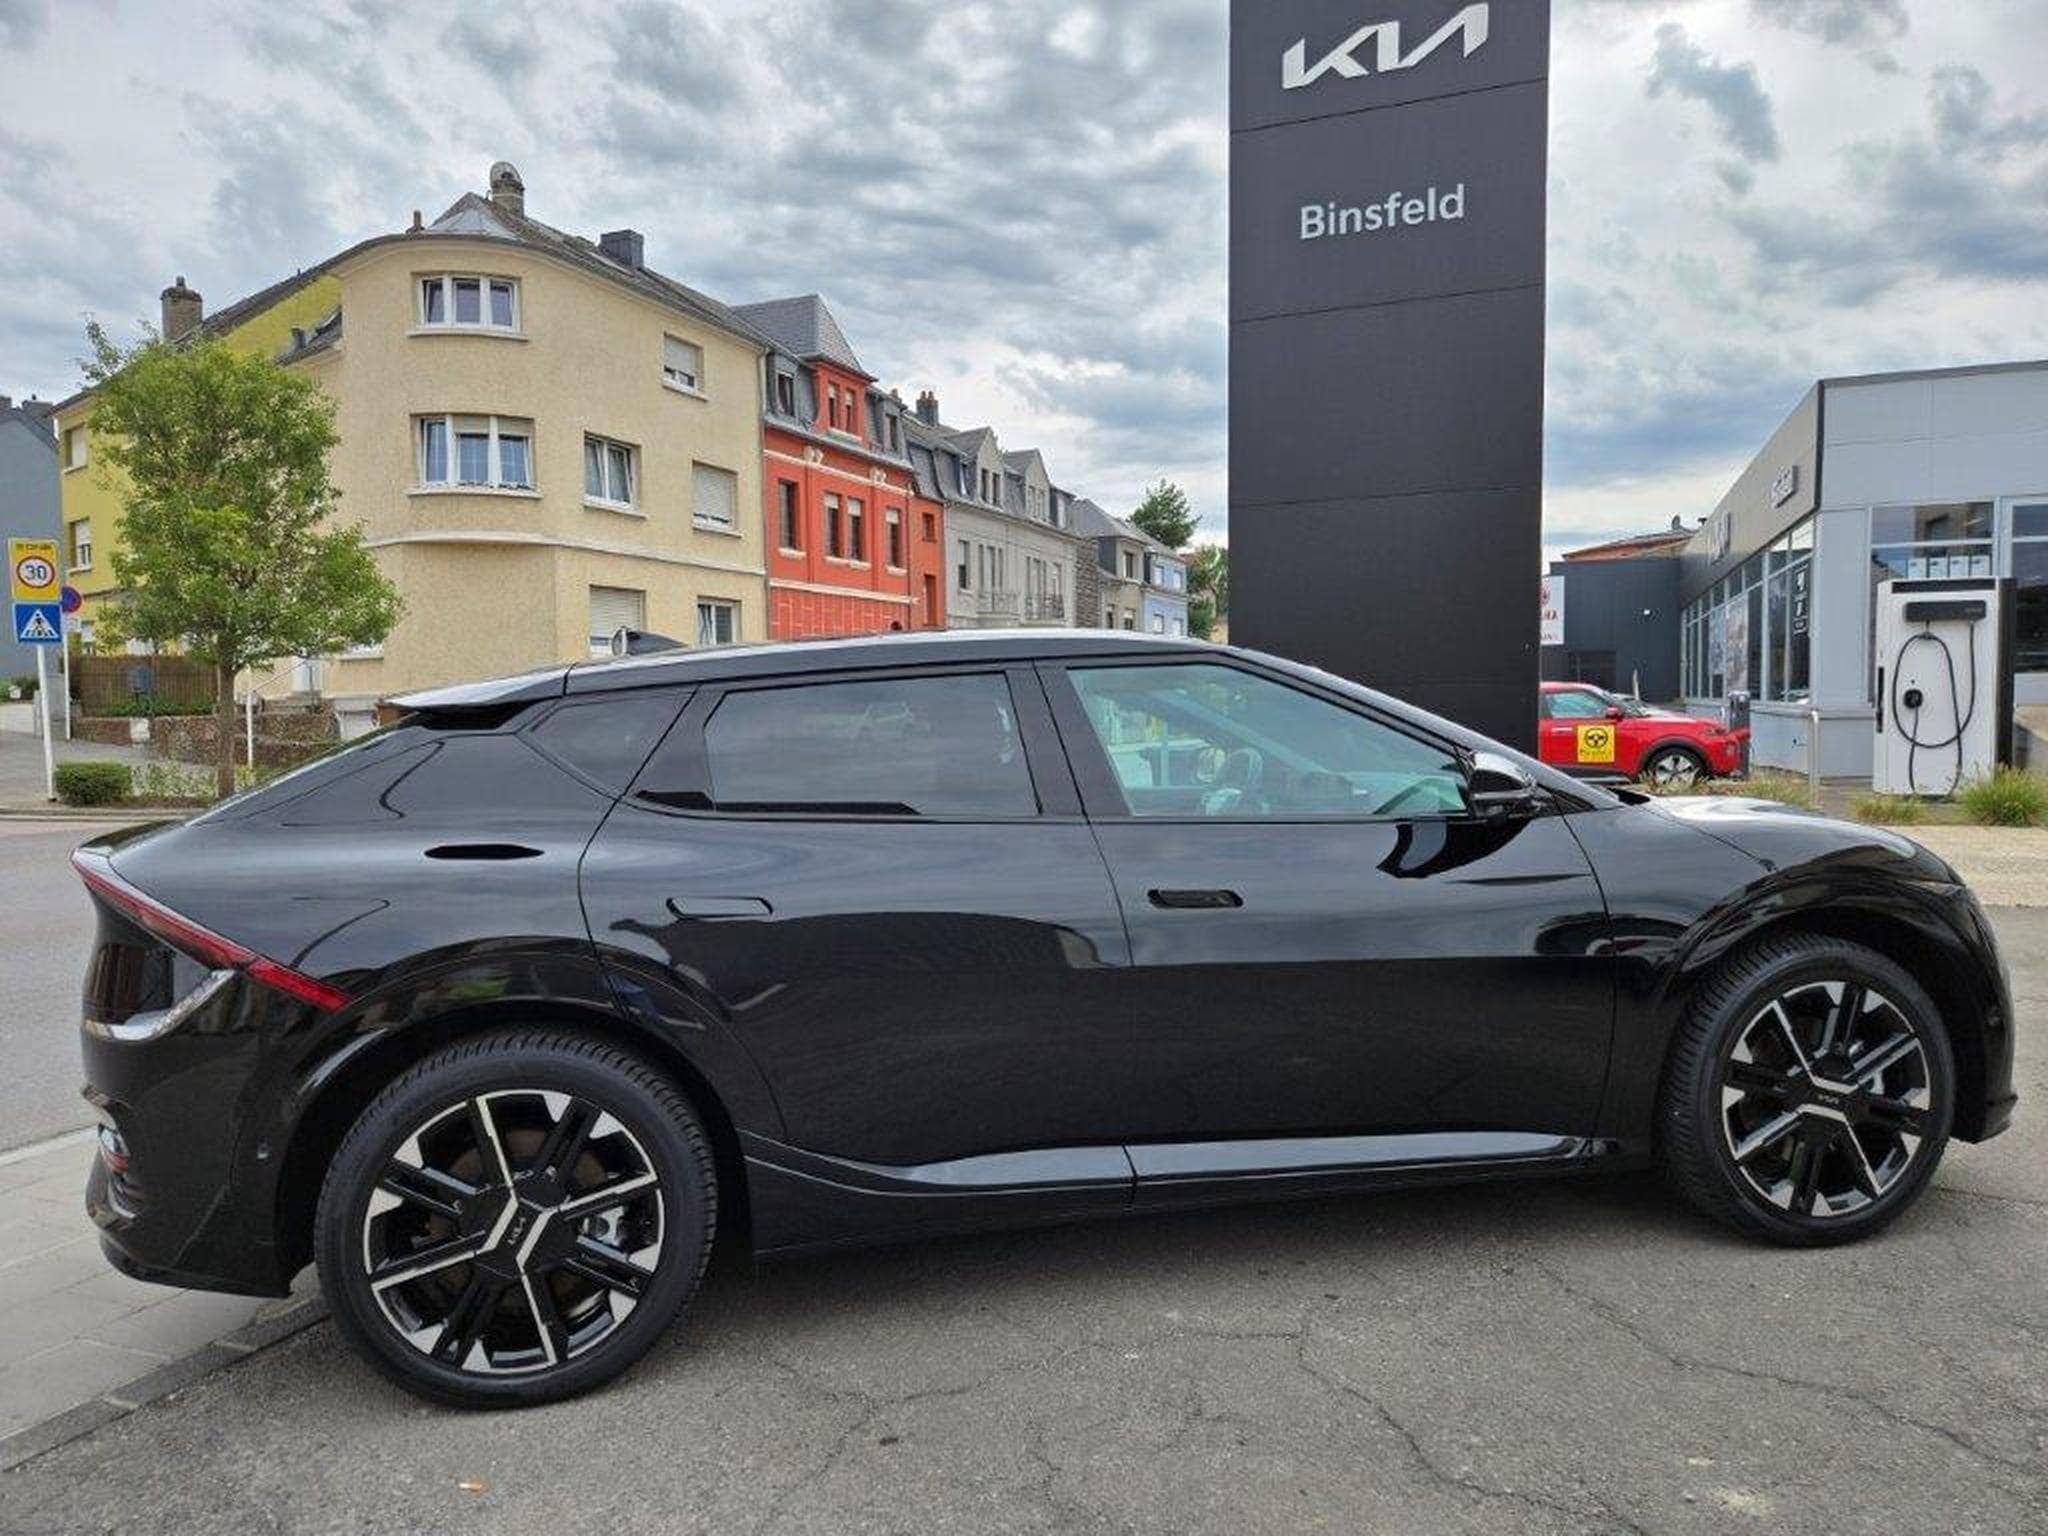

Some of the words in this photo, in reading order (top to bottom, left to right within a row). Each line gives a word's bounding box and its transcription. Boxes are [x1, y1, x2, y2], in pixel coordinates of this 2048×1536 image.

[1282, 2, 1489, 89] KIA
[1300, 182, 1466, 240] Binsfeld
[25, 565, 47, 580] 30
